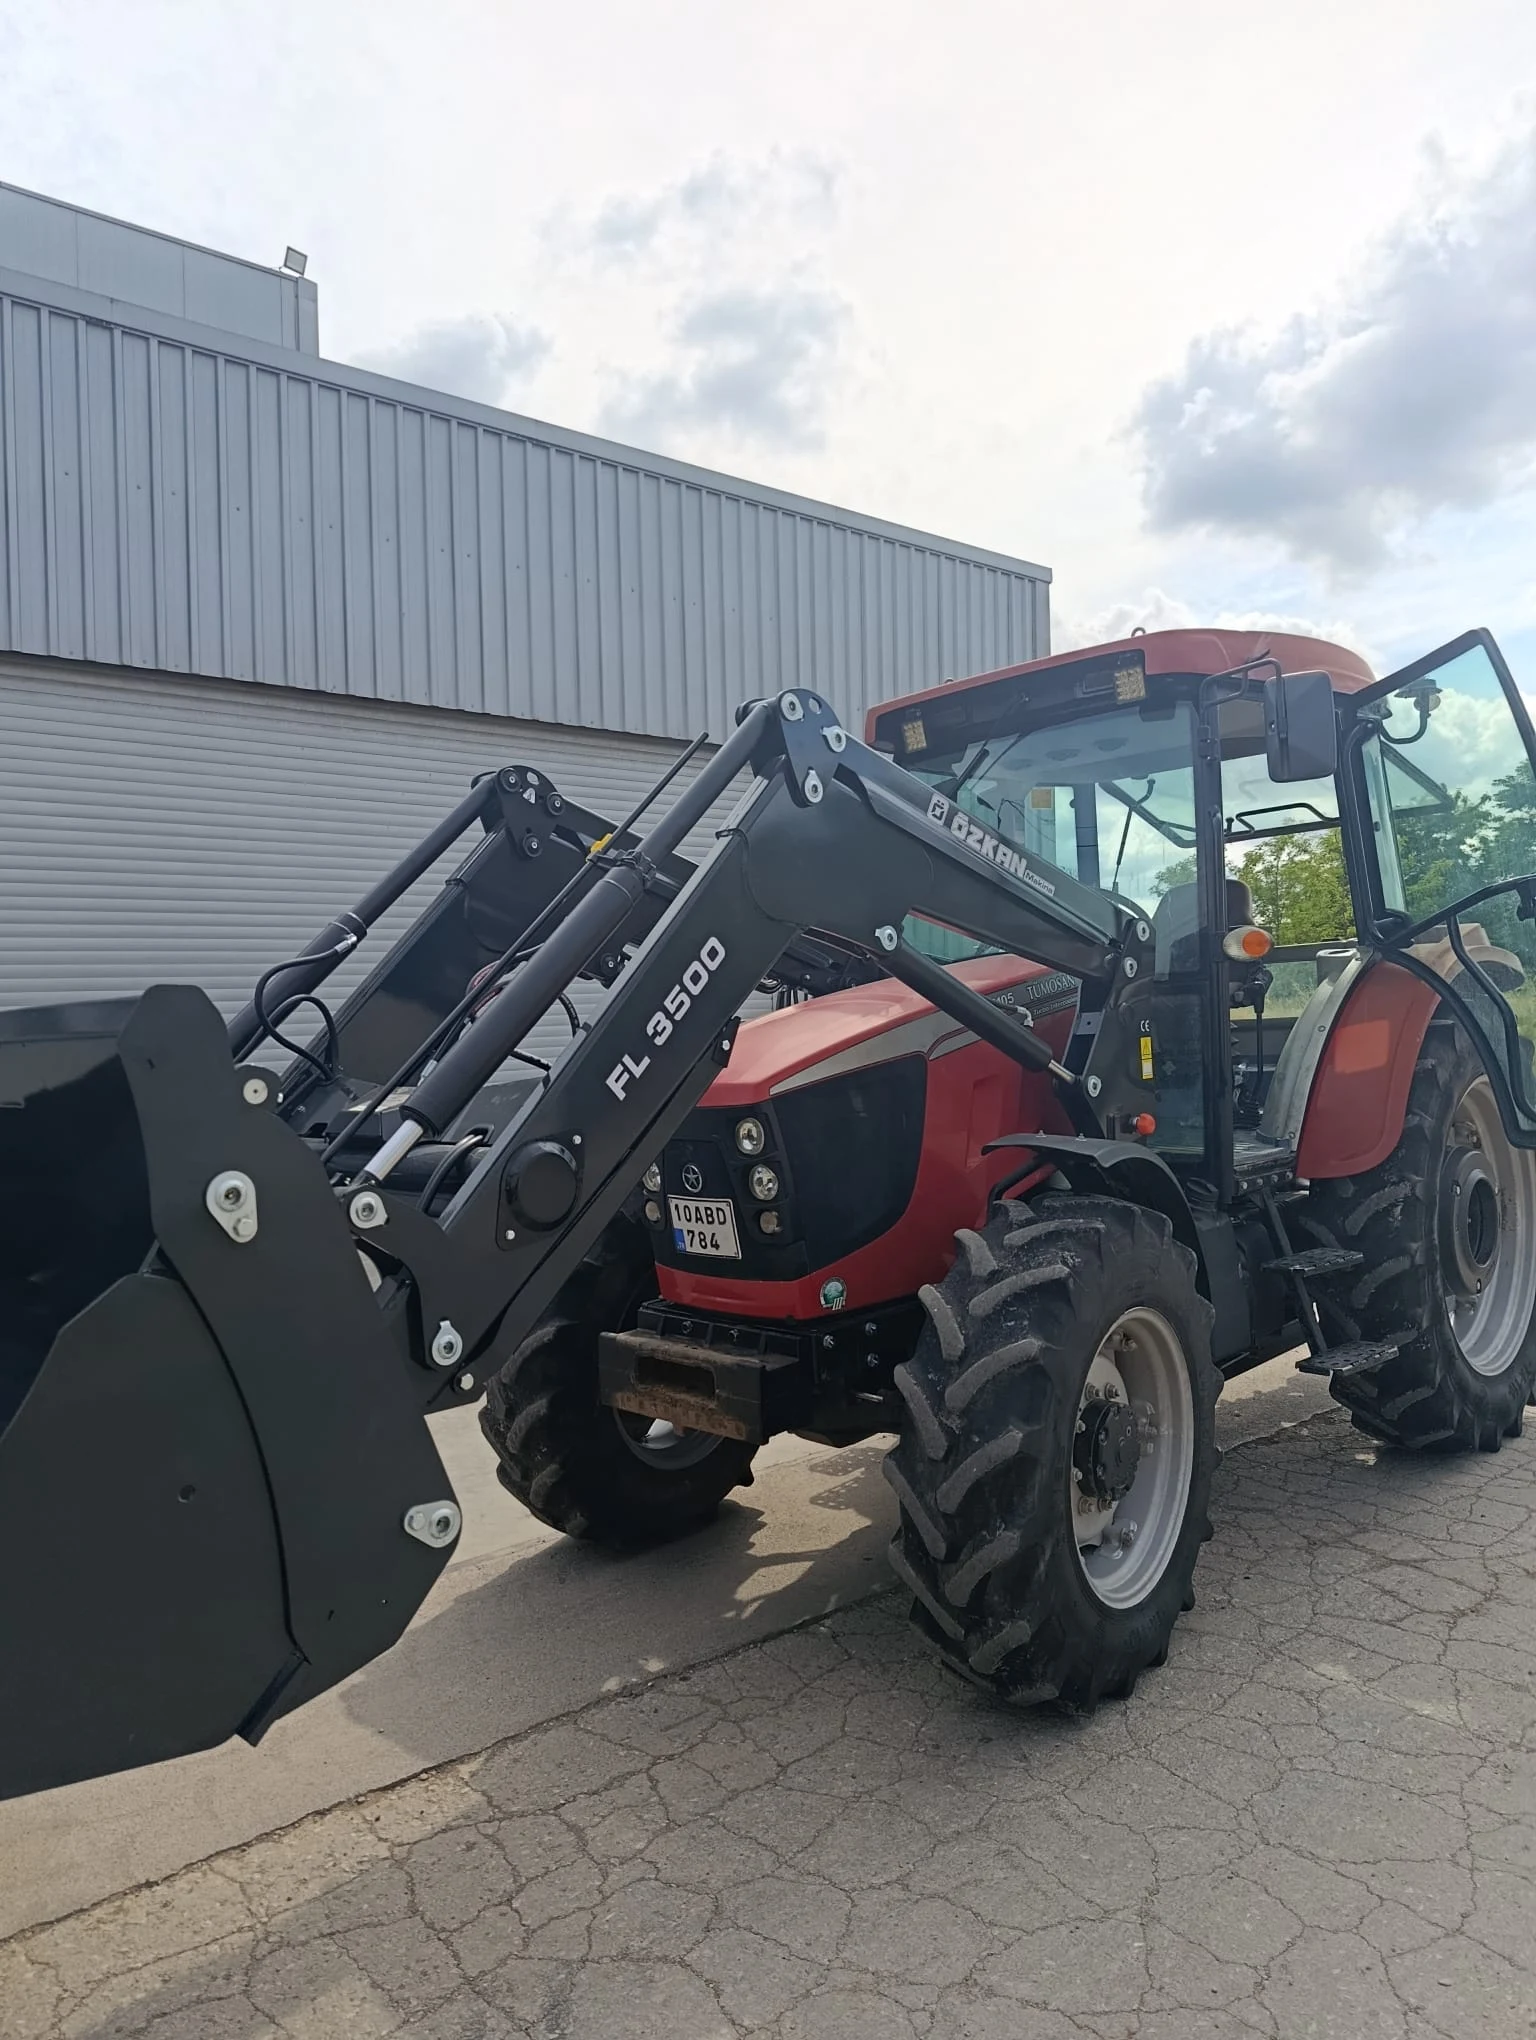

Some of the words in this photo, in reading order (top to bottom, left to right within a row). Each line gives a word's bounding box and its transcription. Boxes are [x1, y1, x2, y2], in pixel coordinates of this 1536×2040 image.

[951, 811, 1028, 878] ÖZKAN
[605, 1053, 651, 1102] FL
[646, 936, 726, 1047] 3500
[1140, 1019, 1151, 1032] CE
[674, 1203, 728, 1226] 10ABD
[687, 1229, 720, 1251] 784
